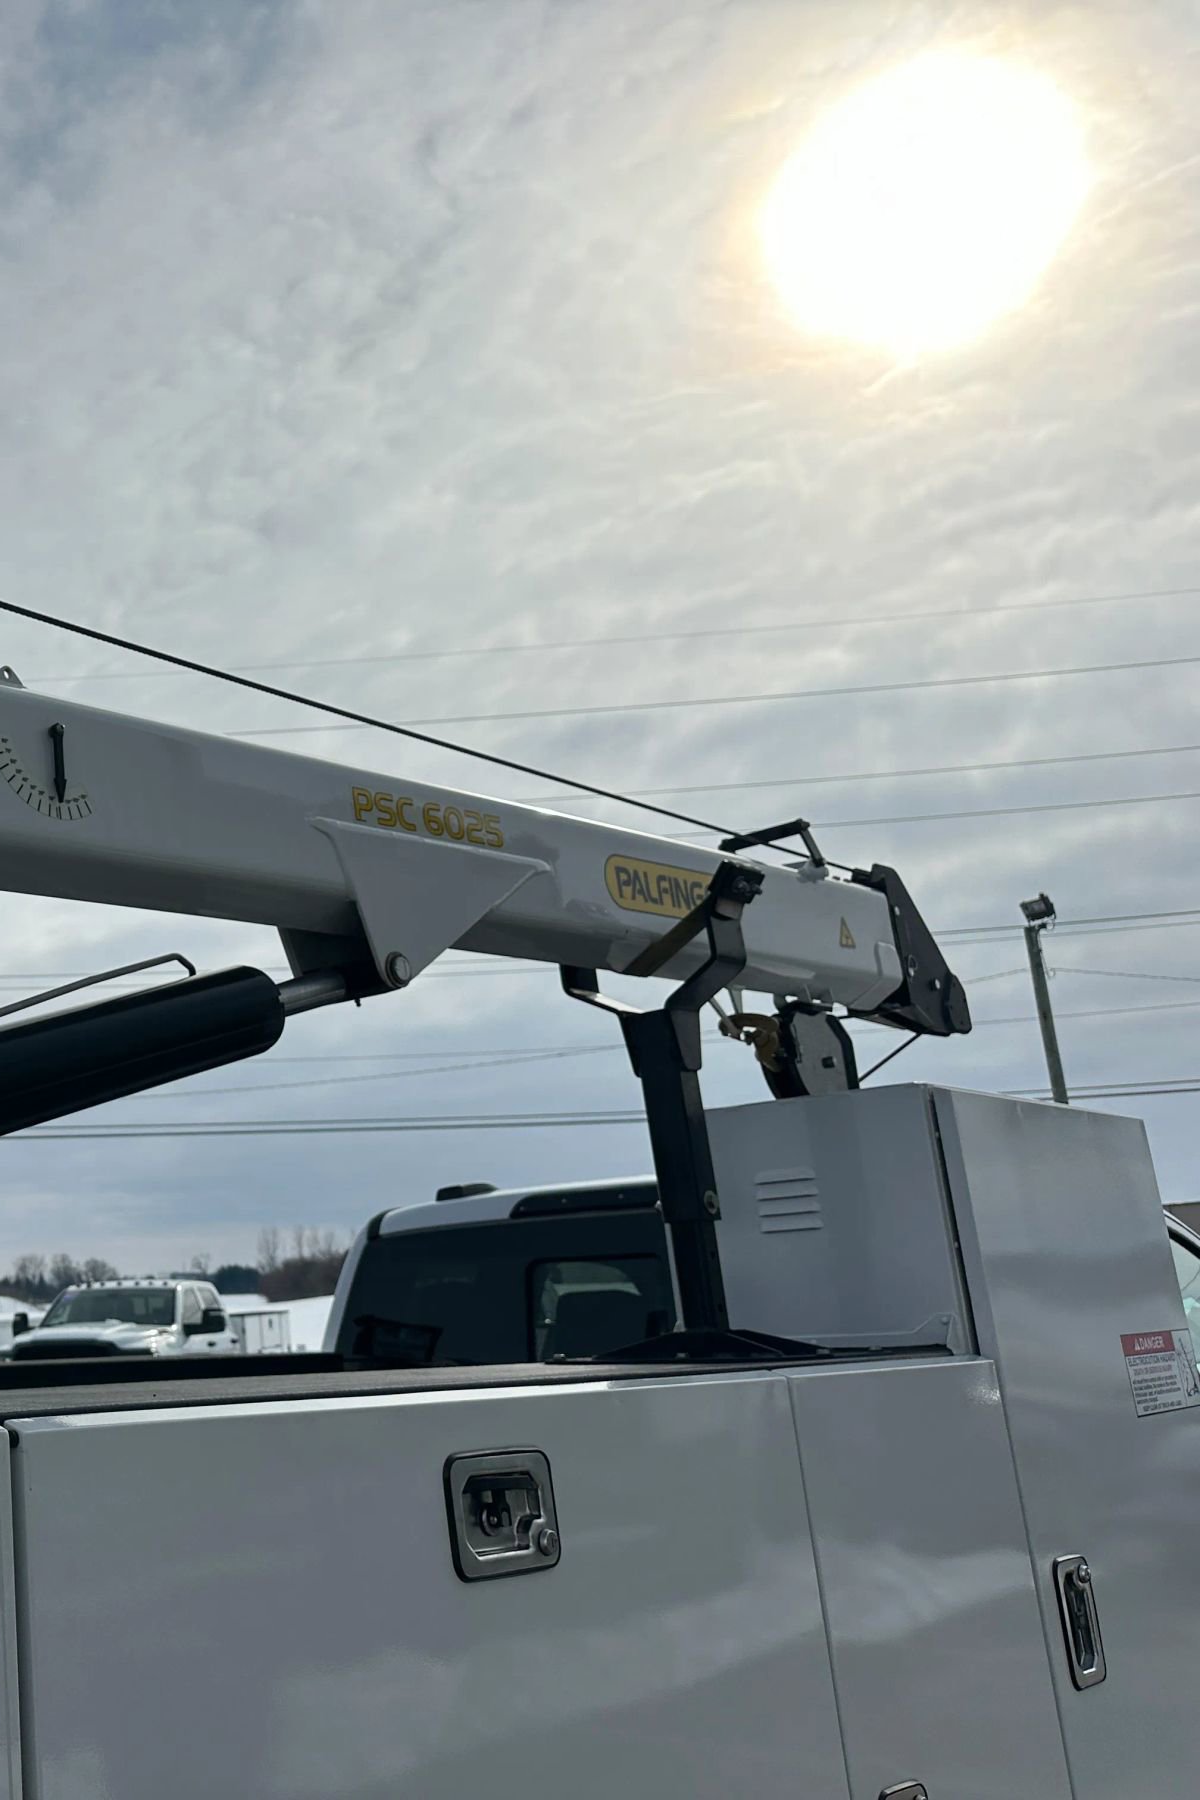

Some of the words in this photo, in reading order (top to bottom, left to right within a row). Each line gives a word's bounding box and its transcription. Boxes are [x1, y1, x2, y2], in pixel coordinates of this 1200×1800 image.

[352, 786, 417, 832] PSC
[422, 802, 504, 848] 6025
[615, 866, 709, 910] PALFING
[1138, 1336, 1164, 1350] DANGER
